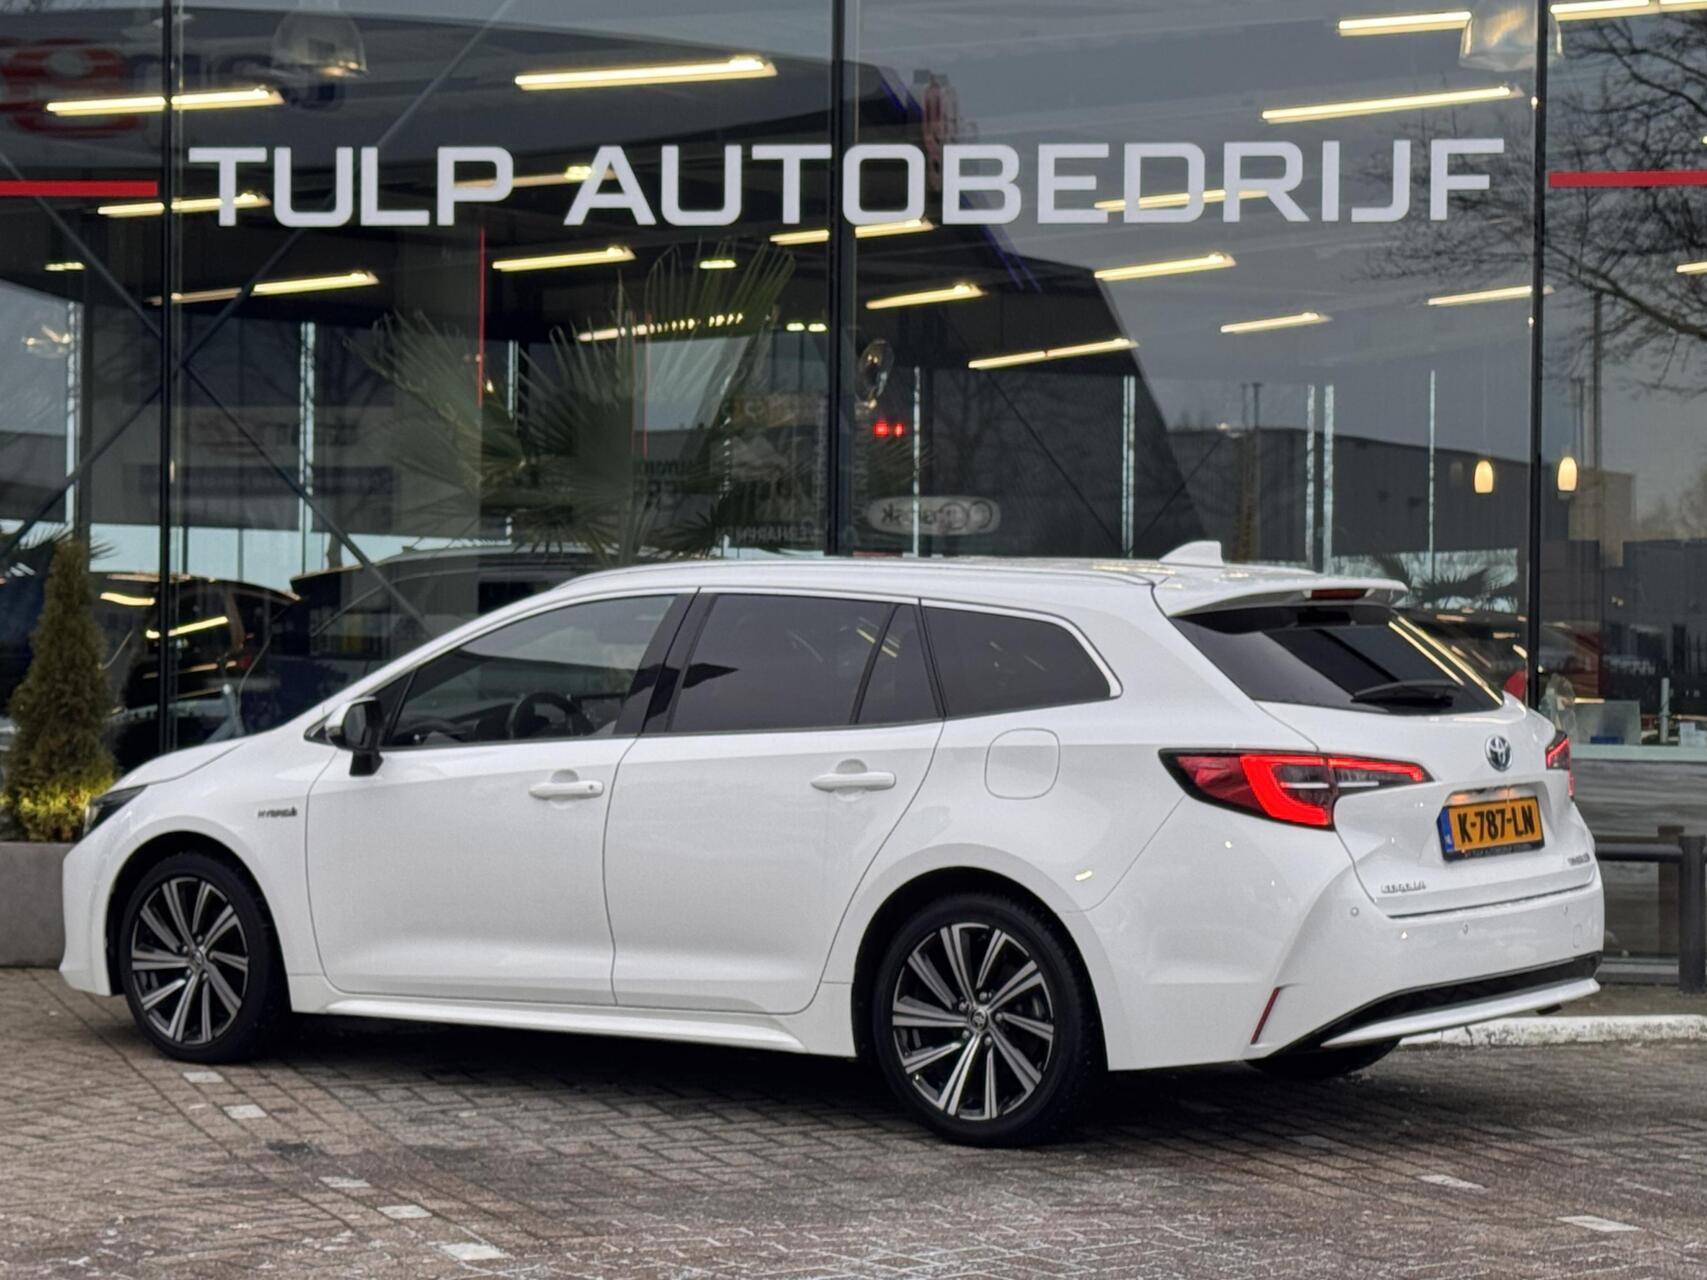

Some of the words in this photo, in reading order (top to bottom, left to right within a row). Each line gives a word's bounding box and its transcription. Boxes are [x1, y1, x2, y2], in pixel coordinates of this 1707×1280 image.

[188, 145, 514, 228] TULP
[563, 138, 1506, 227] AUTOBEDRIJF
[1457, 804, 1536, 844] K-787-LN
